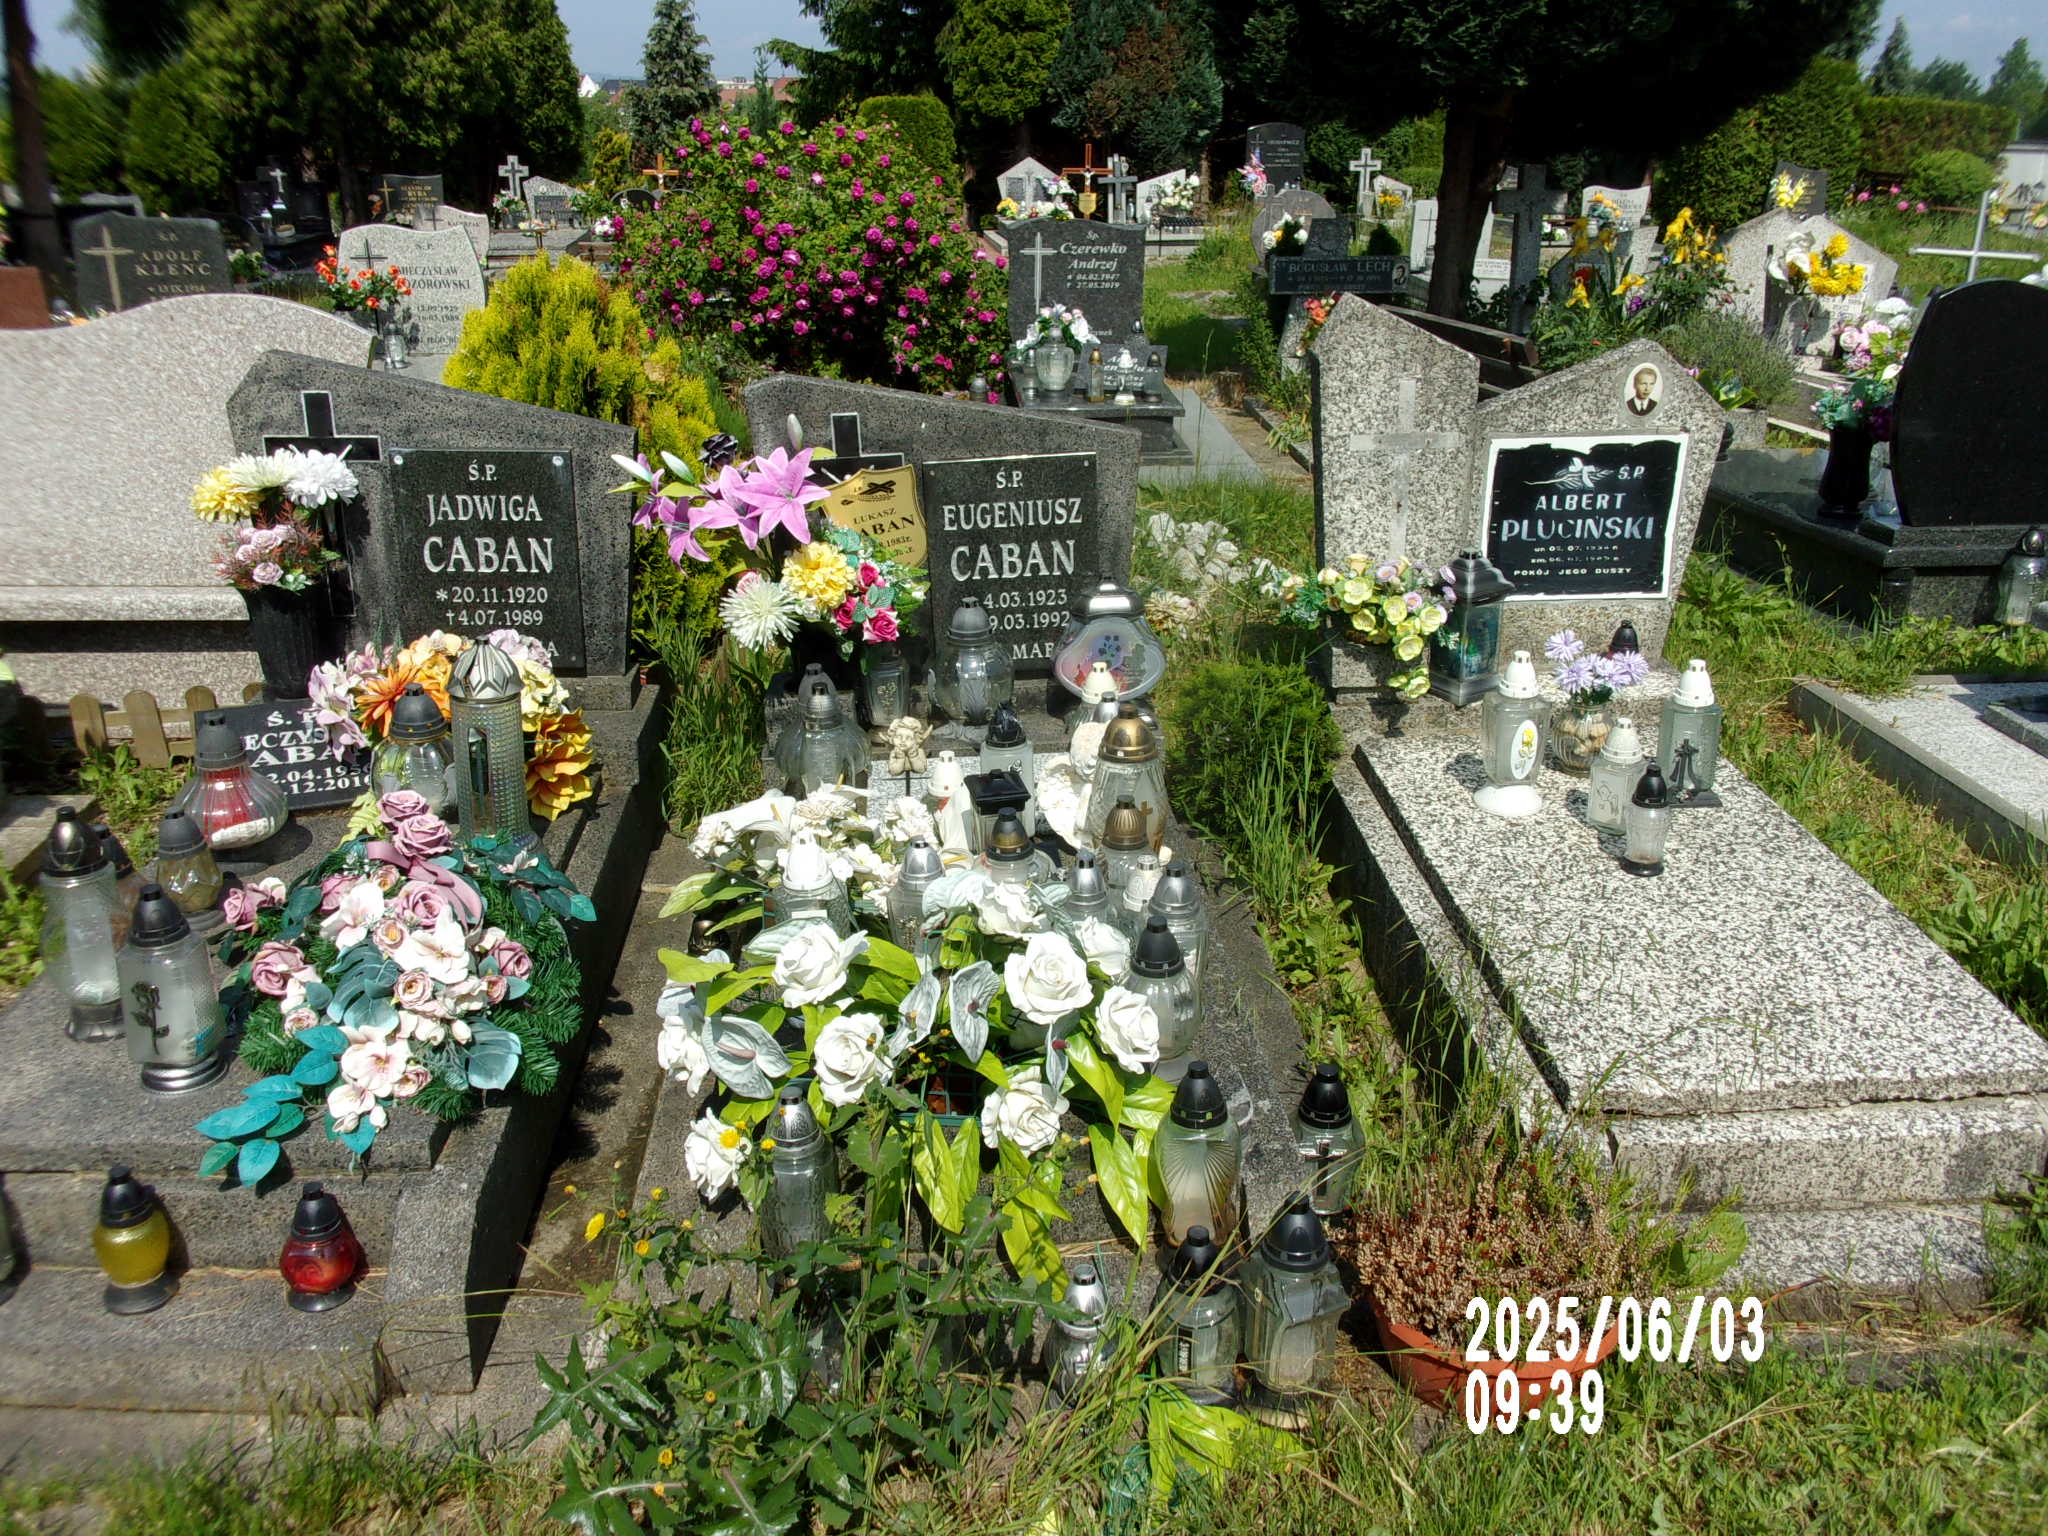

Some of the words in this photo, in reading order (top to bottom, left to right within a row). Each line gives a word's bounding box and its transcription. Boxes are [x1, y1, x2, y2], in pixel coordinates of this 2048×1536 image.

[141, 249, 203, 262] ADOLF
[1060, 242, 1128, 255] Czerewko
[134, 262, 212, 276] KLENC
[1067, 258, 1118, 272] Andrzej
[468, 459, 498, 481] Ś.P.
[995, 466, 1024, 489] Ś.P.
[426, 493, 544, 528] JADWIGA
[1534, 492, 1628, 512] ALBERT
[942, 497, 1083, 531] EUGENIUSZ
[859, 514, 915, 537] ABAN
[423, 535, 554, 574] CABAN
[950, 539, 1076, 582] CABAN
[1513, 568, 1550, 576] POKÓJ
[1558, 568, 1588, 576] JEGO
